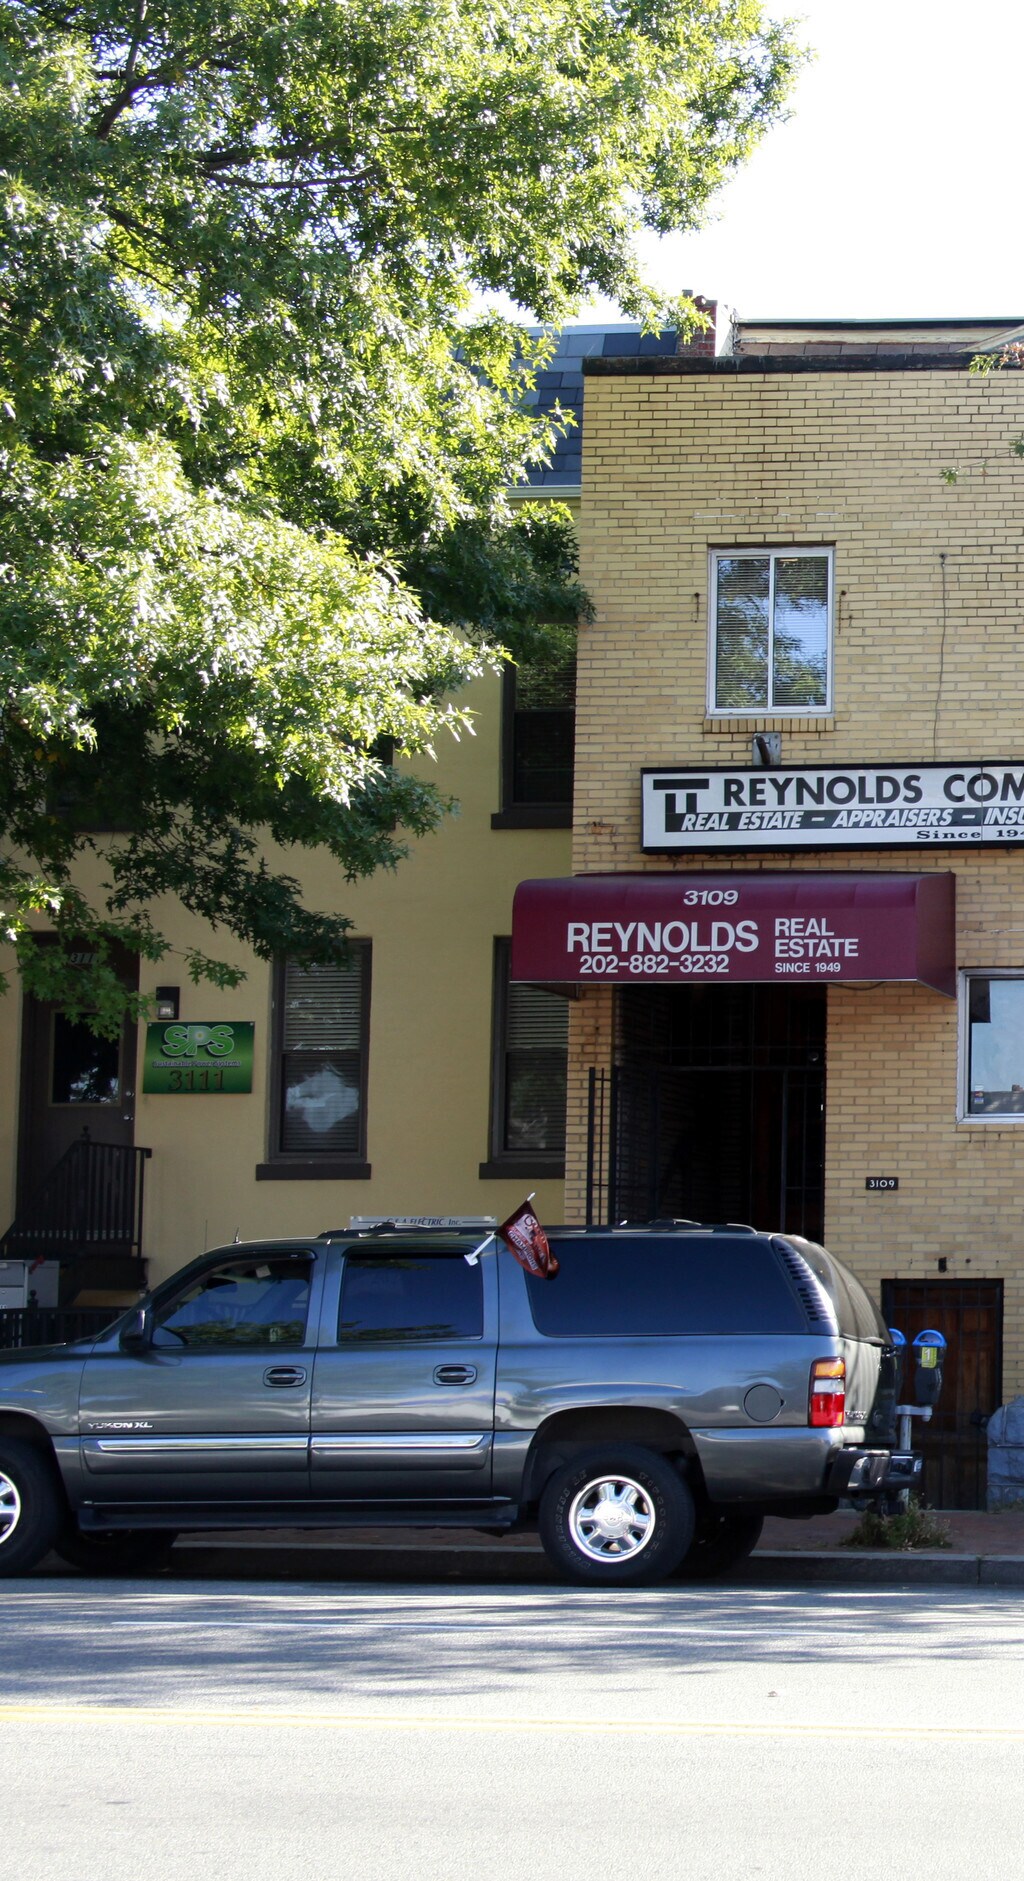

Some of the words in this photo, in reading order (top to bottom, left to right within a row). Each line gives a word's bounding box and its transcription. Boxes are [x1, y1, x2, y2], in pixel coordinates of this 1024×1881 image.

[723, 775, 922, 806] REYNOLDS
[681, 813, 730, 831] REAL
[738, 811, 804, 830] ESTATE
[832, 808, 954, 828] APPRAISERS
[916, 830, 981, 839] Since
[683, 890, 738, 905] 3109
[566, 920, 759, 953] REYNOLDS
[774, 918, 834, 937] REAL
[70, 953, 98, 963] 311
[774, 938, 859, 958] ESTATE
[579, 954, 729, 974] 202-882-3232
[774, 962, 811, 973] SINCE
[814, 962, 841, 973] 1949
[161, 1025, 235, 1056] SPS
[168, 1070, 224, 1091] 3111
[869, 1179, 895, 1188] 3109
